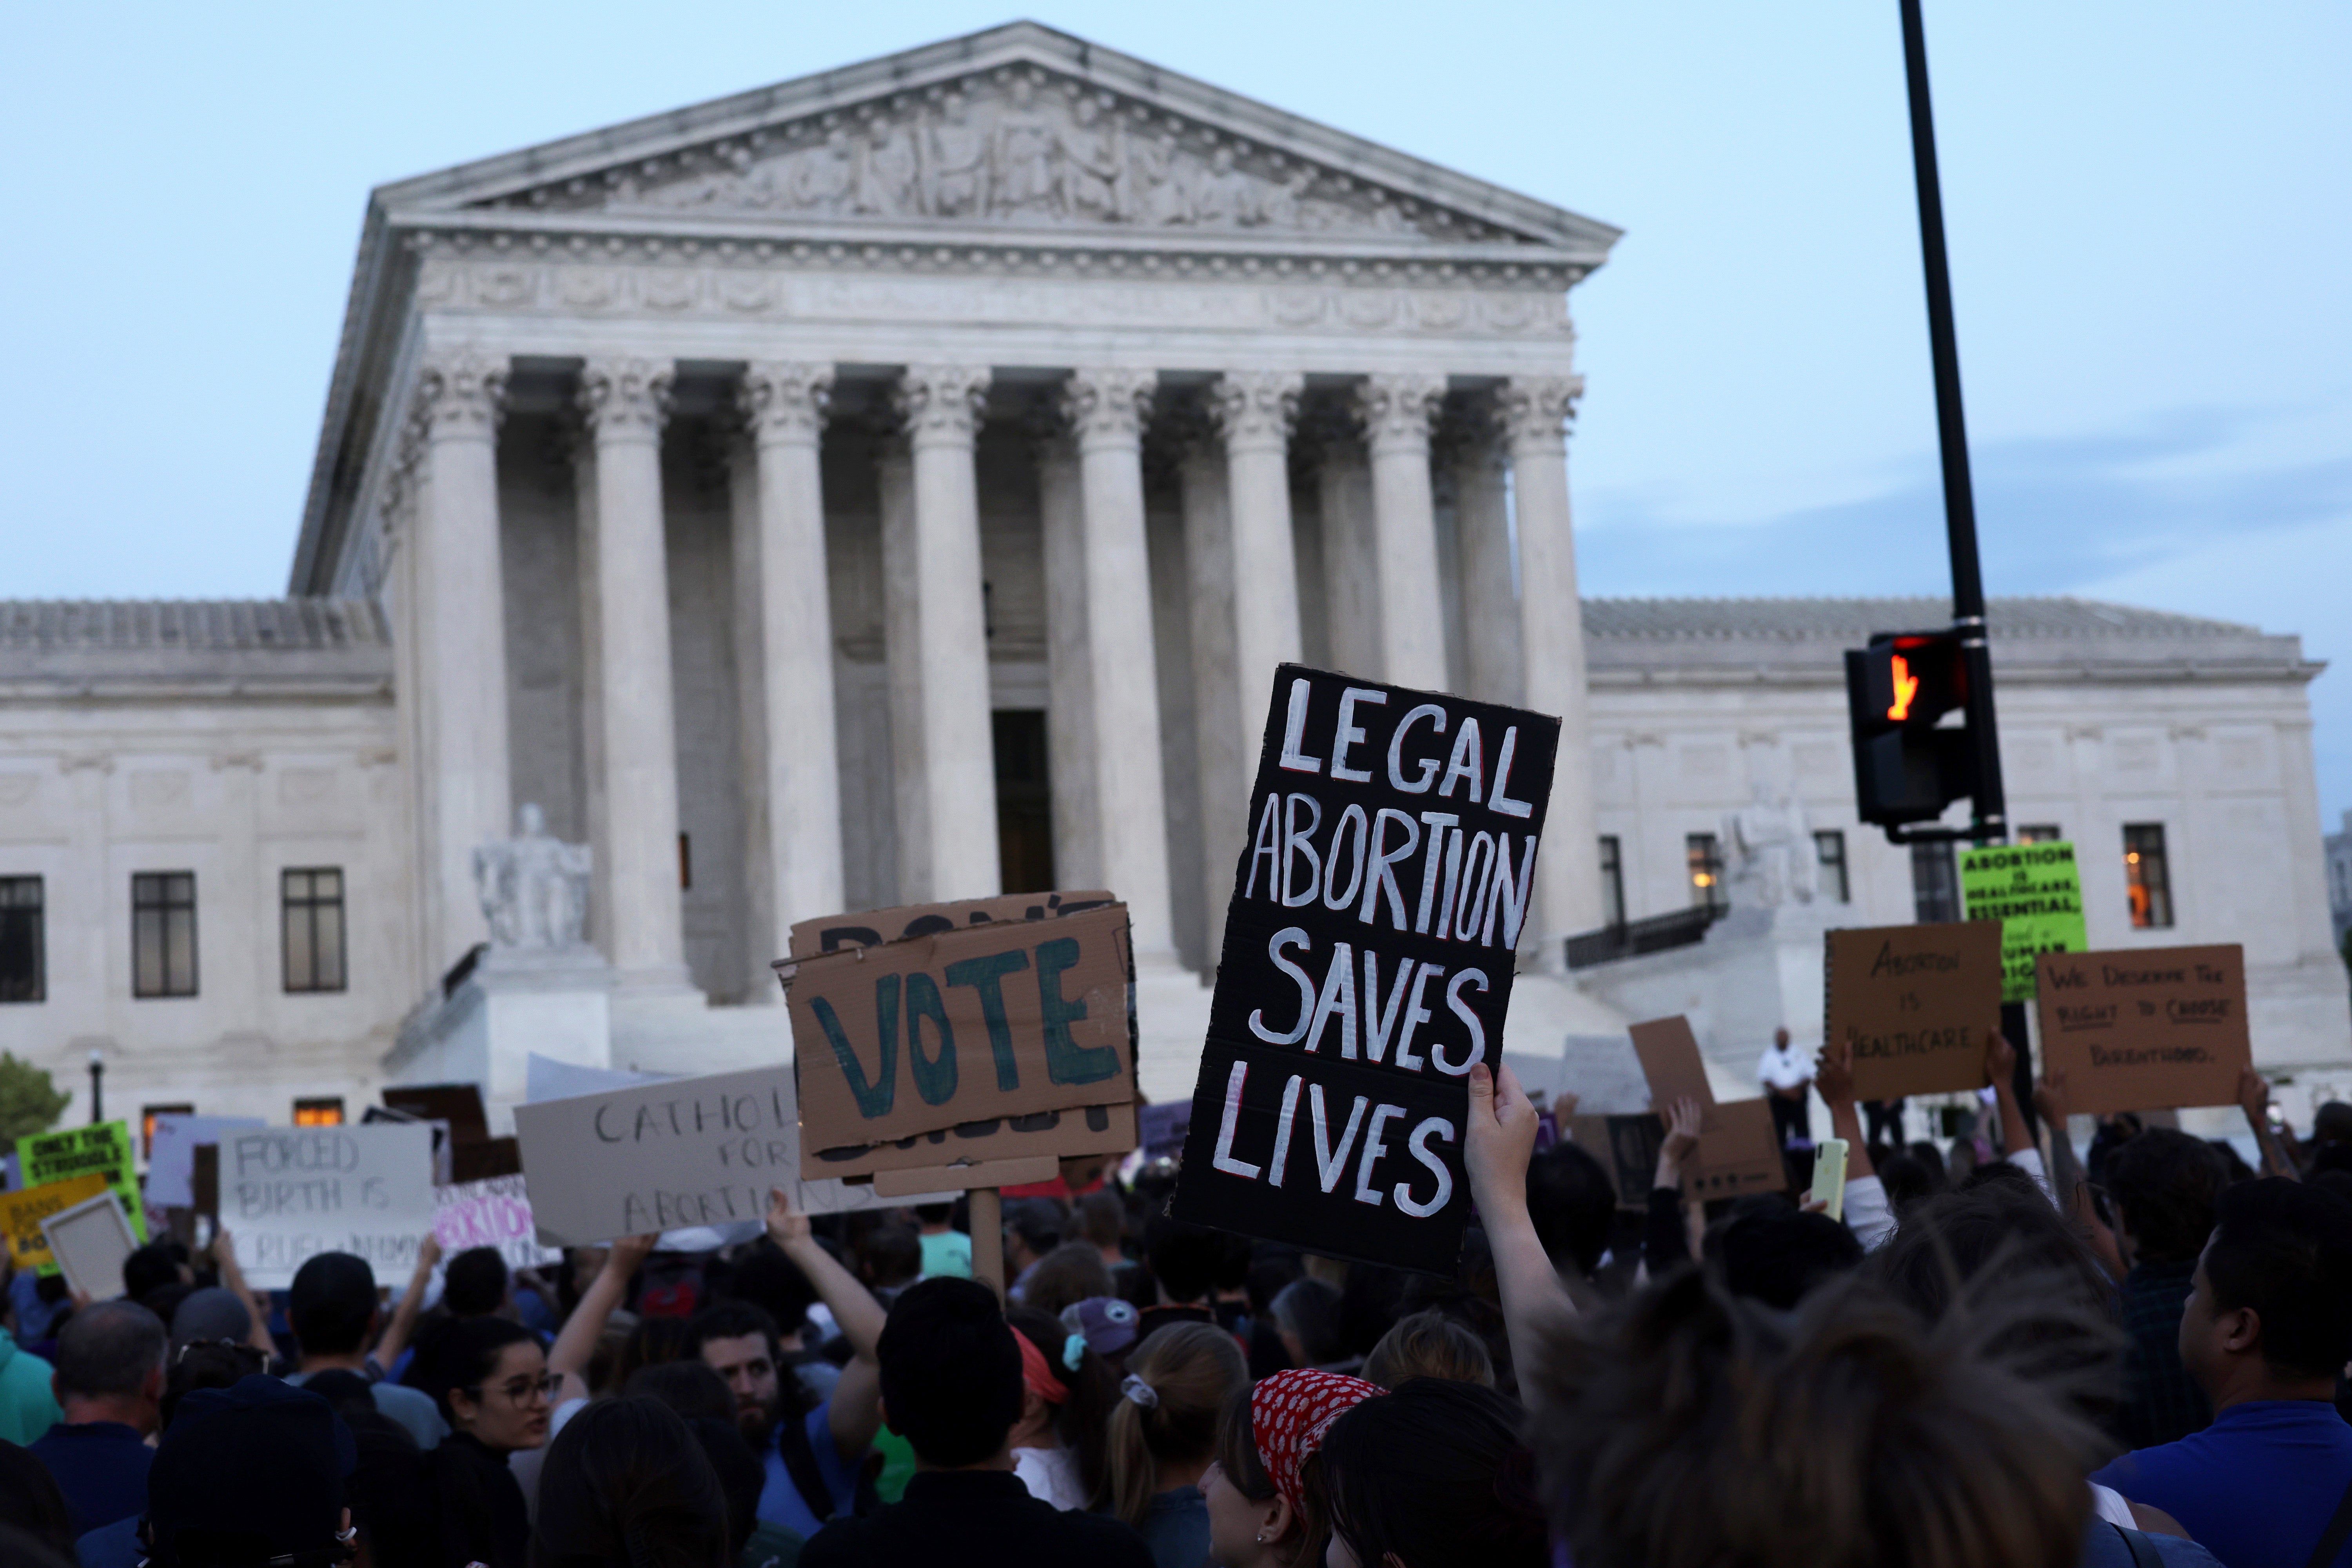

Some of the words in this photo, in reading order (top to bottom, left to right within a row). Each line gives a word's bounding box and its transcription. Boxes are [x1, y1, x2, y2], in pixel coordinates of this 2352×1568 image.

[1279, 678, 1534, 818] LEGAL
[1245, 792, 1536, 950] ABORTION
[1964, 848, 2074, 871] ABORTION
[2003, 942, 2066, 960] UMAN
[1249, 927, 1489, 1076] SAVES
[2047, 964, 2089, 989] WE
[809, 937, 1122, 1118] VOTE
[594, 1087, 799, 1143] CATHOL
[1213, 1061, 1455, 1218] LIVES
[235, 1131, 360, 1176] FORCED
[719, 1138, 792, 1168] FOR
[237, 1178, 342, 1220] BIRTH
[361, 1176, 390, 1210] IS
